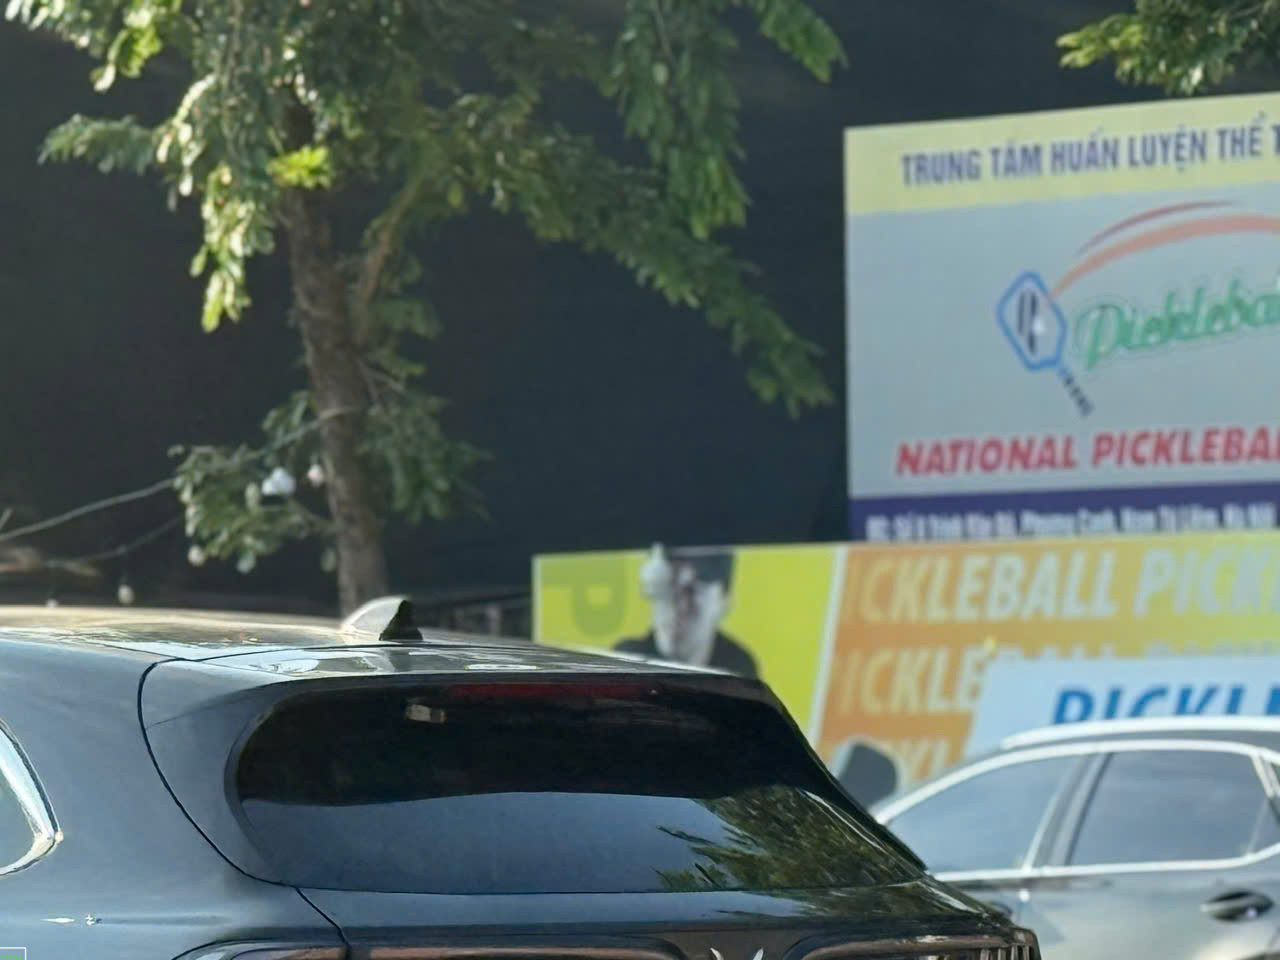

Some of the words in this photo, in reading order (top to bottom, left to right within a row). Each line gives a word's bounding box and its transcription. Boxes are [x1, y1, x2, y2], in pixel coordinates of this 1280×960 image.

[902, 149, 982, 186] TRUNG
[991, 138, 1043, 179] TÂM
[1127, 123, 1207, 174] LUYỆN
[895, 434, 1078, 477] NATIONAL
